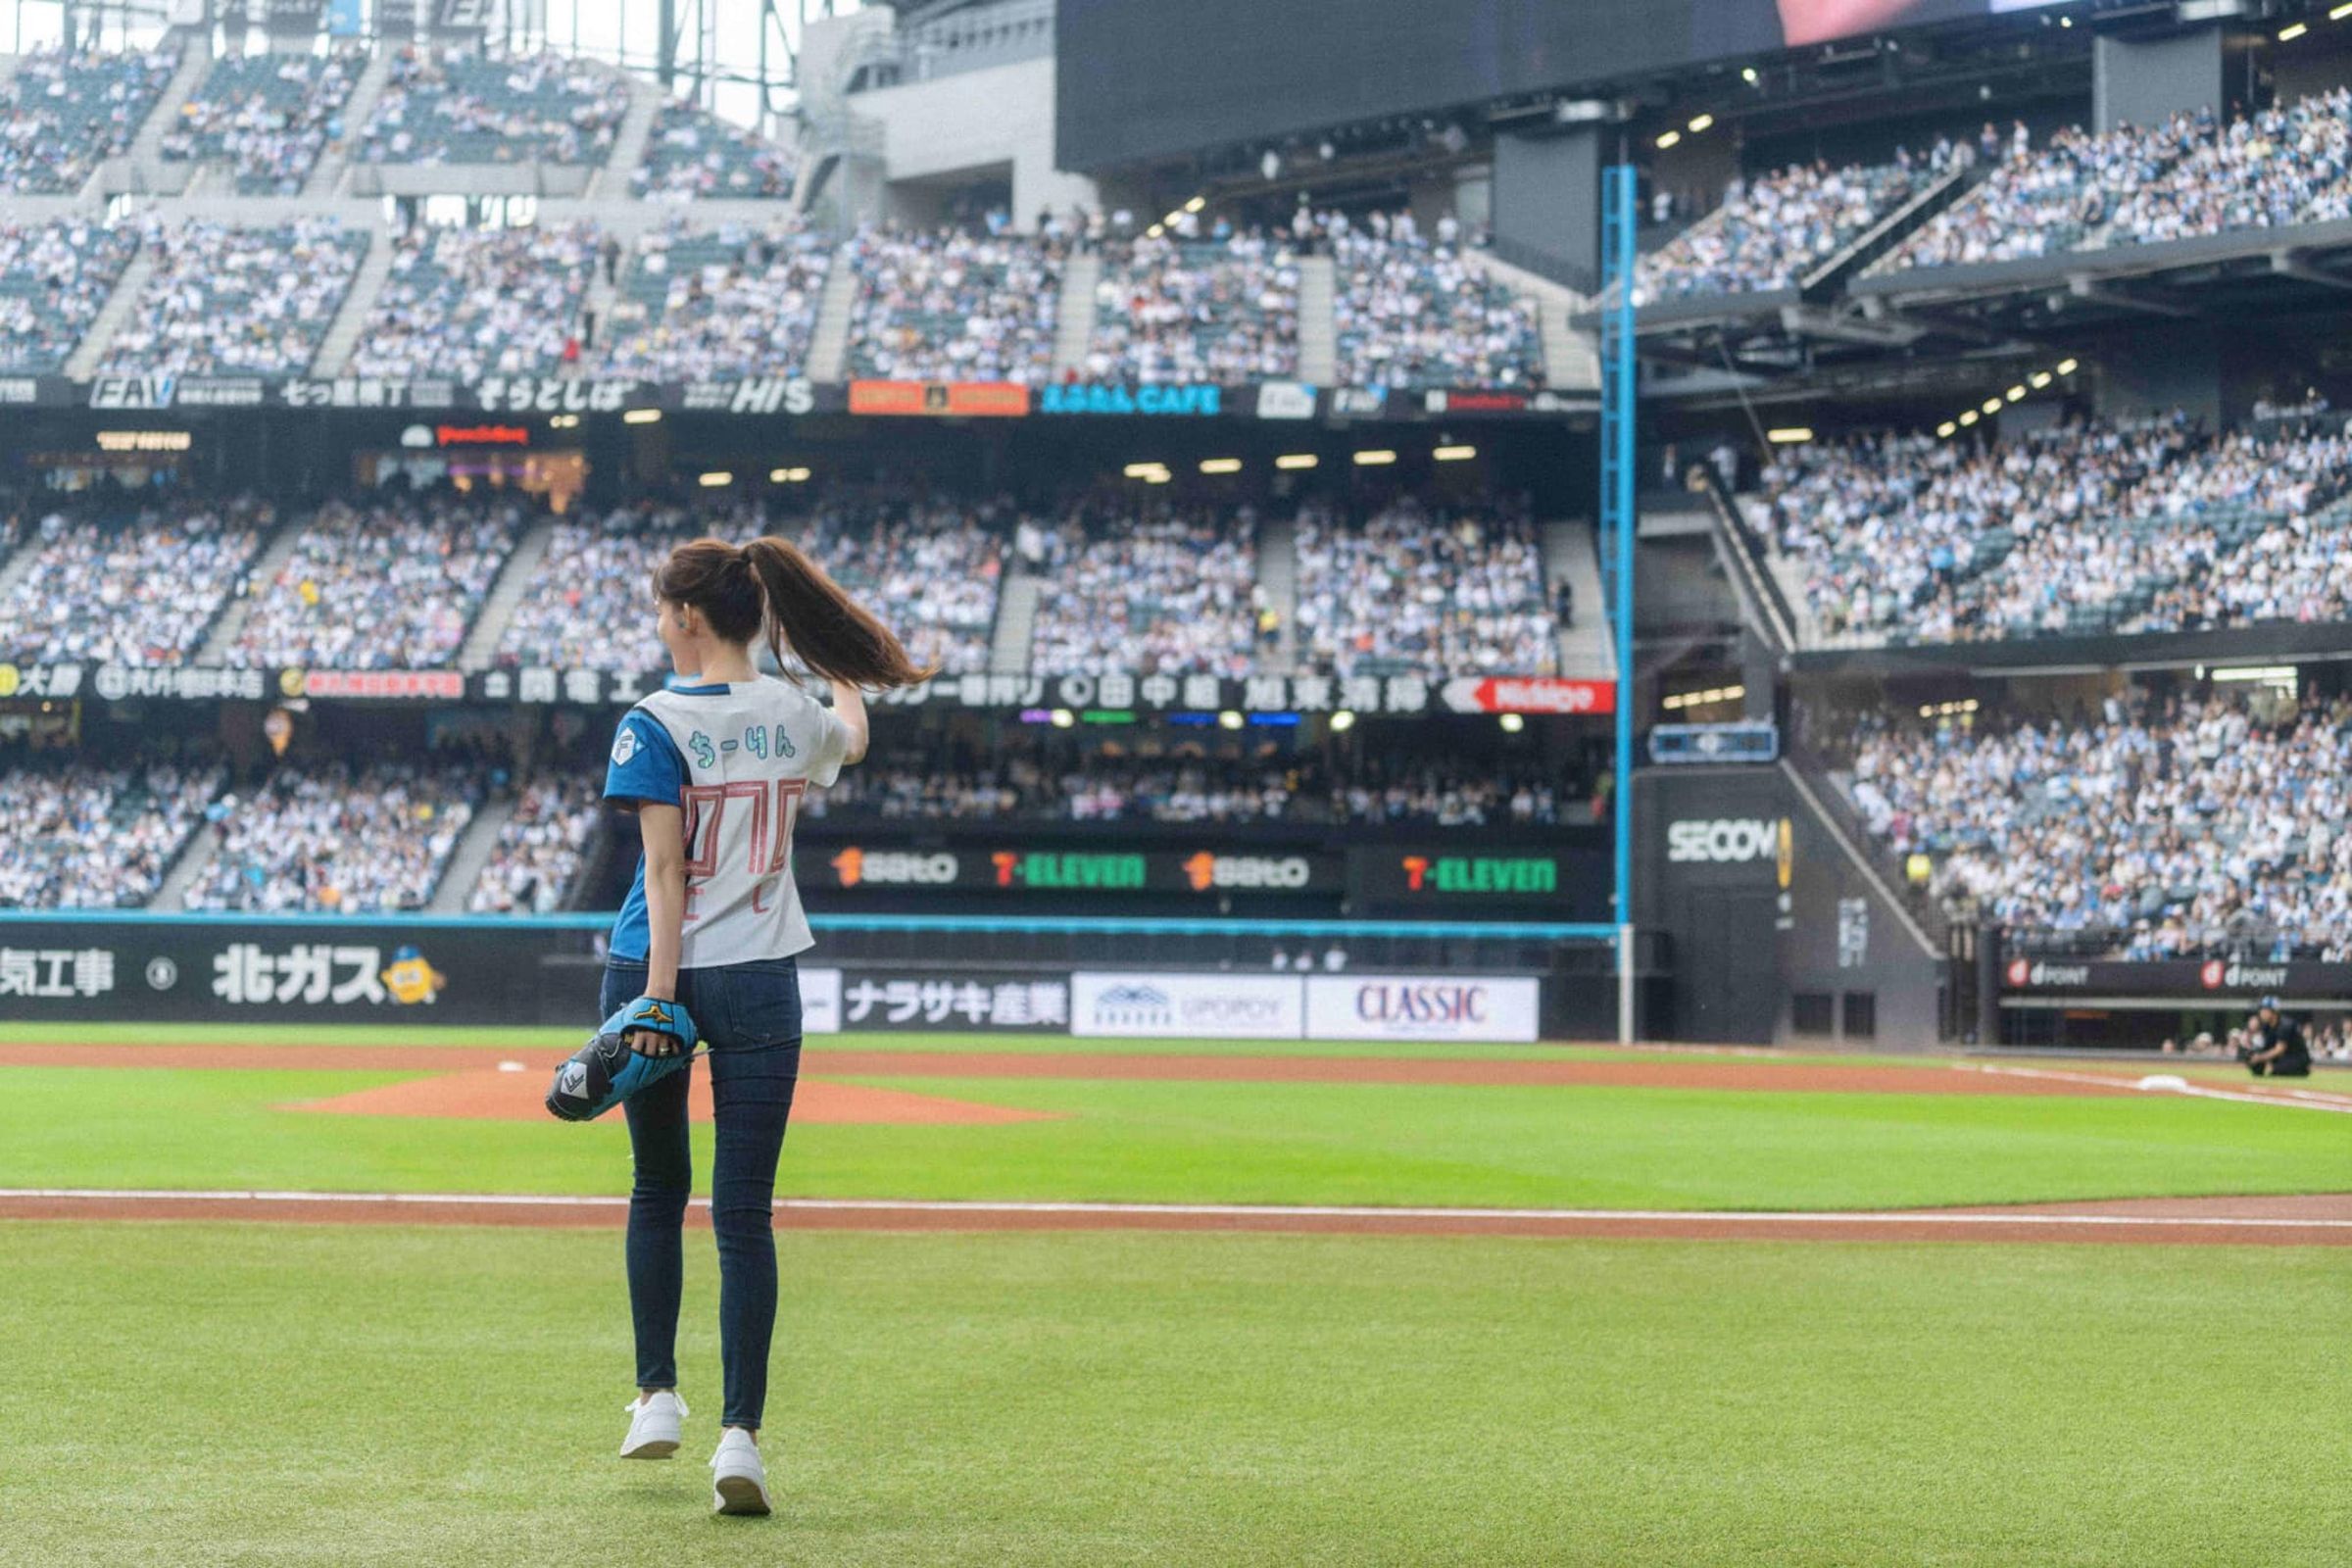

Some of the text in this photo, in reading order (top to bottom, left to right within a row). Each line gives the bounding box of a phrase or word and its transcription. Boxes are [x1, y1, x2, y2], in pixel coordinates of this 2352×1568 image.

[212, 943, 387, 1004] 北ガス
[844, 980, 1069, 1026] ナラサキ産業
[1355, 984, 1488, 1024] CLASSIC
